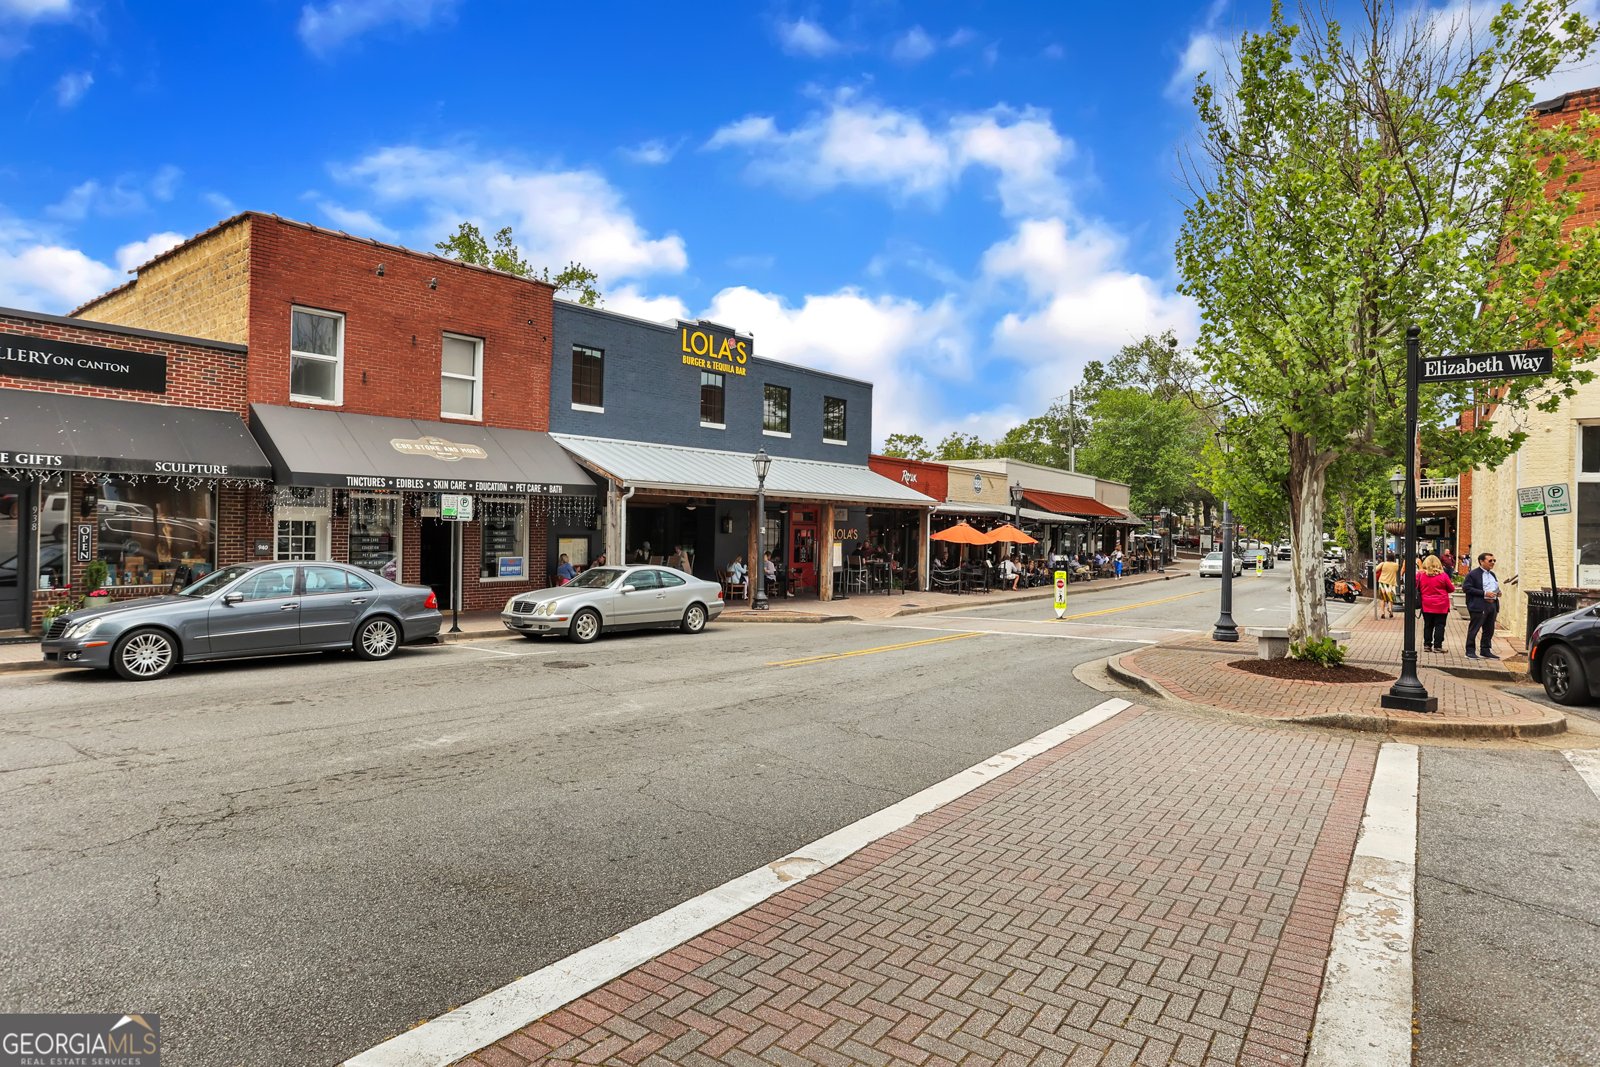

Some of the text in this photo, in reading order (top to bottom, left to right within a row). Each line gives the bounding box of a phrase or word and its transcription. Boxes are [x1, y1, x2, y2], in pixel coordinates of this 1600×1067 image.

[53, 355, 74, 367] ON
[77, 359, 130, 373] CANTON
[682, 355, 706, 368] BURGER
[713, 361, 735, 374] TEQUILA
[735, 366, 747, 376] BAR
[1424, 353, 1544, 377] Elizabeth Way
[15, 453, 62, 465] GIFTS
[155, 461, 228, 475] SCULPTURE
[346, 476, 562, 493] TINCTURES EDIBLES SKIN CARE EDUCATION PET CARE BATH
[80, 526, 90, 559] OPEN
